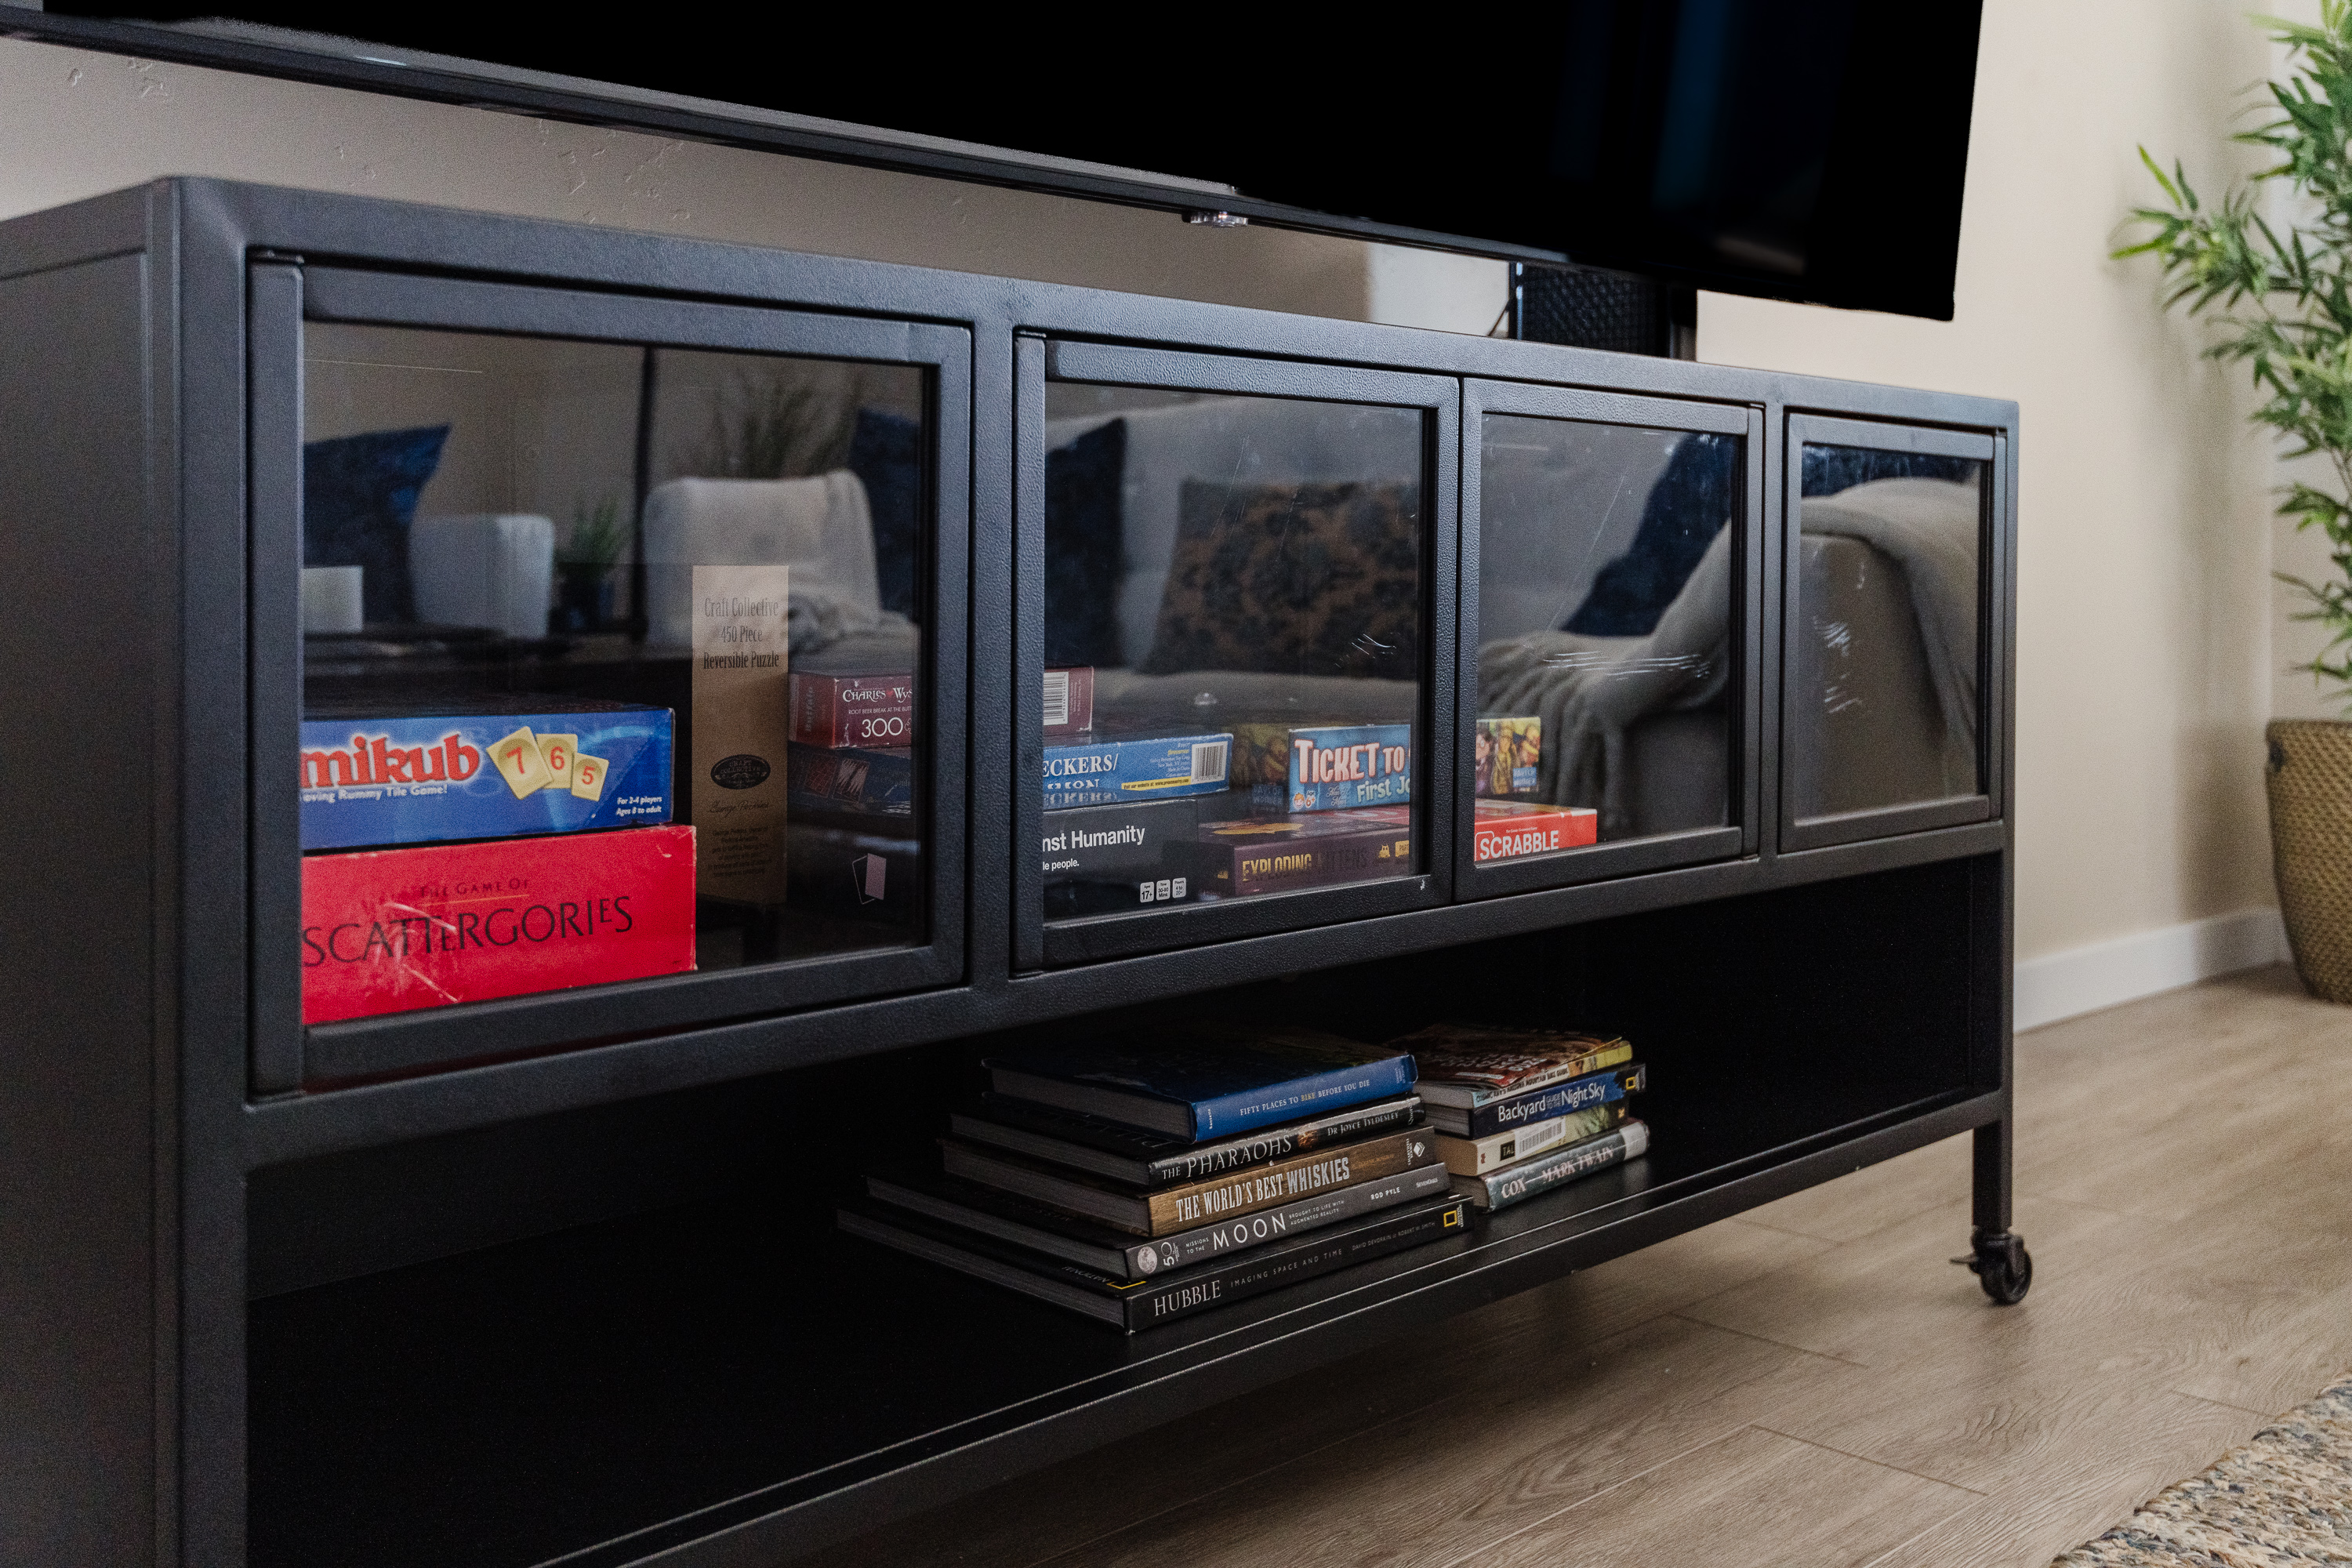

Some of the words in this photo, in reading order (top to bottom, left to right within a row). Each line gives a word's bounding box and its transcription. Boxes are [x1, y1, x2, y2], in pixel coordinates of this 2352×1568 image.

[705, 597, 728, 618] Craft
[731, 597, 779, 617] Collective
[720, 626, 737, 643] 450
[739, 625, 763, 643] Piece
[703, 652, 749, 670] Reversible
[751, 650, 779, 668] Puzzle
[861, 717, 904, 738] 300
[300, 735, 479, 788] mikub
[506, 746, 525, 775] 7
[550, 746, 565, 771] 6
[1294, 739, 1380, 783] TICKET
[1382, 746, 1405, 775] TO
[582, 765, 595, 785] 5
[300, 790, 336, 803] oving
[338, 788, 383, 800] Rummy
[387, 786, 408, 797] Tile
[410, 784, 448, 796] Game!
[640, 796, 662, 805] players
[1356, 779, 1392, 803] First
[615, 808, 631, 816] Ages
[1071, 825, 1145, 849] Humanity
[1479, 830, 1559, 860] SCRABBLE
[1051, 858, 1080, 871] people.
[1242, 853, 1312, 882] EXPLODING
[1142, 890, 1152, 900] 17+
[302, 896, 633, 967] SCATTERGORIES
[1240, 1105, 1260, 1116] FIFTY
[1262, 1100, 1287, 1111] PLACES
[1288, 1096, 1299, 1105] TO
[1318, 1086, 1342, 1098] BEFORE
[1344, 1083, 1357, 1091] YOU
[1359, 1079, 1370, 1088] DIE
[1562, 1087, 1588, 1109] Night
[1588, 1083, 1606, 1101] Sky
[1498, 1095, 1546, 1123] Backyard
[1162, 1166, 1181, 1180] THE
[1185, 1134, 1292, 1178] PHARAOHS
[1340, 1121, 1361, 1134] JOYCE
[1363, 1111, 1399, 1127] TYLDESLEY
[1501, 1178, 1526, 1199] COX
[1541, 1160, 1576, 1184] MARK
[1577, 1146, 1614, 1174] TWAIN
[1176, 1195, 1200, 1222] THE
[1203, 1181, 1254, 1215] WORLD'S
[1256, 1173, 1283, 1202] BEST
[1287, 1156, 1350, 1195] WHISKIES
[1370, 1192, 1384, 1200] ROD
[1385, 1186, 1401, 1196] PYLE
[1289, 1209, 1312, 1219] BROUGHT
[1333, 1200, 1345, 1208] WITH
[1290, 1214, 1319, 1225] AUGMENTED
[1320, 1208, 1340, 1218] REALITY
[1185, 1237, 1210, 1247] MISSIONS
[1213, 1213, 1286, 1250] MOON
[1352, 1242, 1367, 1250] DAVID
[1398, 1227, 1415, 1236] ROBERT
[1421, 1221, 1436, 1230] SMITH
[1161, 1241, 1174, 1266] 50
[1154, 1279, 1221, 1317] HUBBLE
[1230, 1270, 1269, 1287] IMAGING
[1272, 1261, 1298, 1275] SPACE
[1302, 1255, 1319, 1266] AND
[1323, 1248, 1342, 1260] TIME
